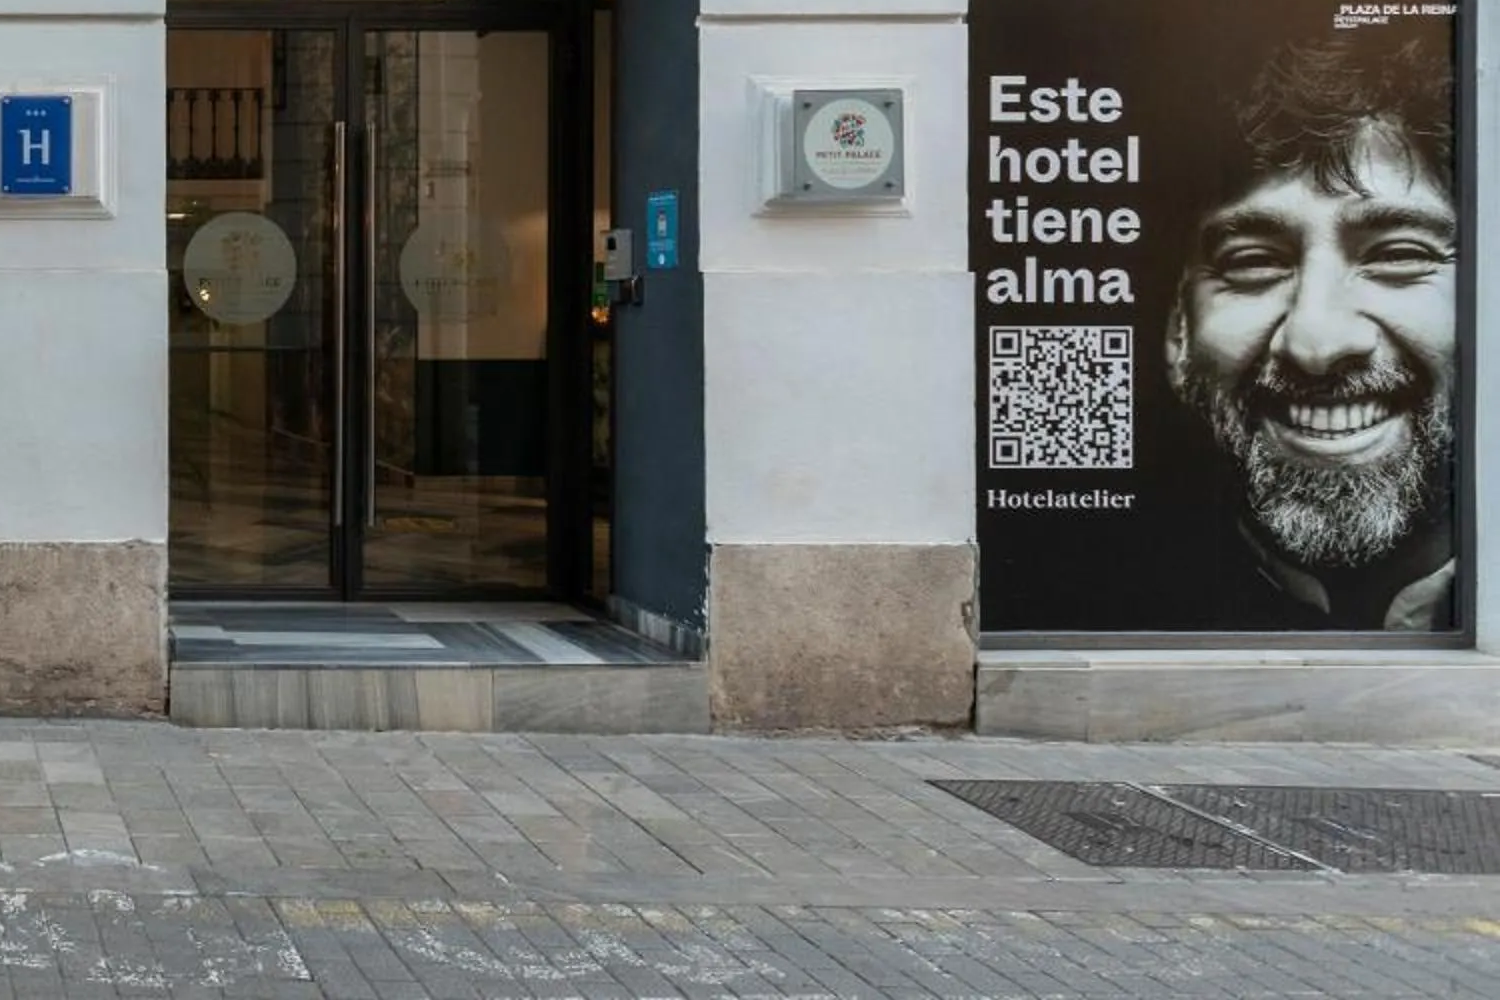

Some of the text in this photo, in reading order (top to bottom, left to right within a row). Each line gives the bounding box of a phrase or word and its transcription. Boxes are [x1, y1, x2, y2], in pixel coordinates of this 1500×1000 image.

[1340, 4, 1380, 15] PLAZA
[1383, 4, 1401, 15] DE
[1402, 4, 1419, 15] LA
[989, 75, 1123, 123] Este
[17, 128, 50, 165] H
[989, 136, 1140, 183] hotel
[986, 197, 1141, 244] tiene
[986, 257, 1135, 304] alma
[987, 489, 1136, 510] Hotelatelier
